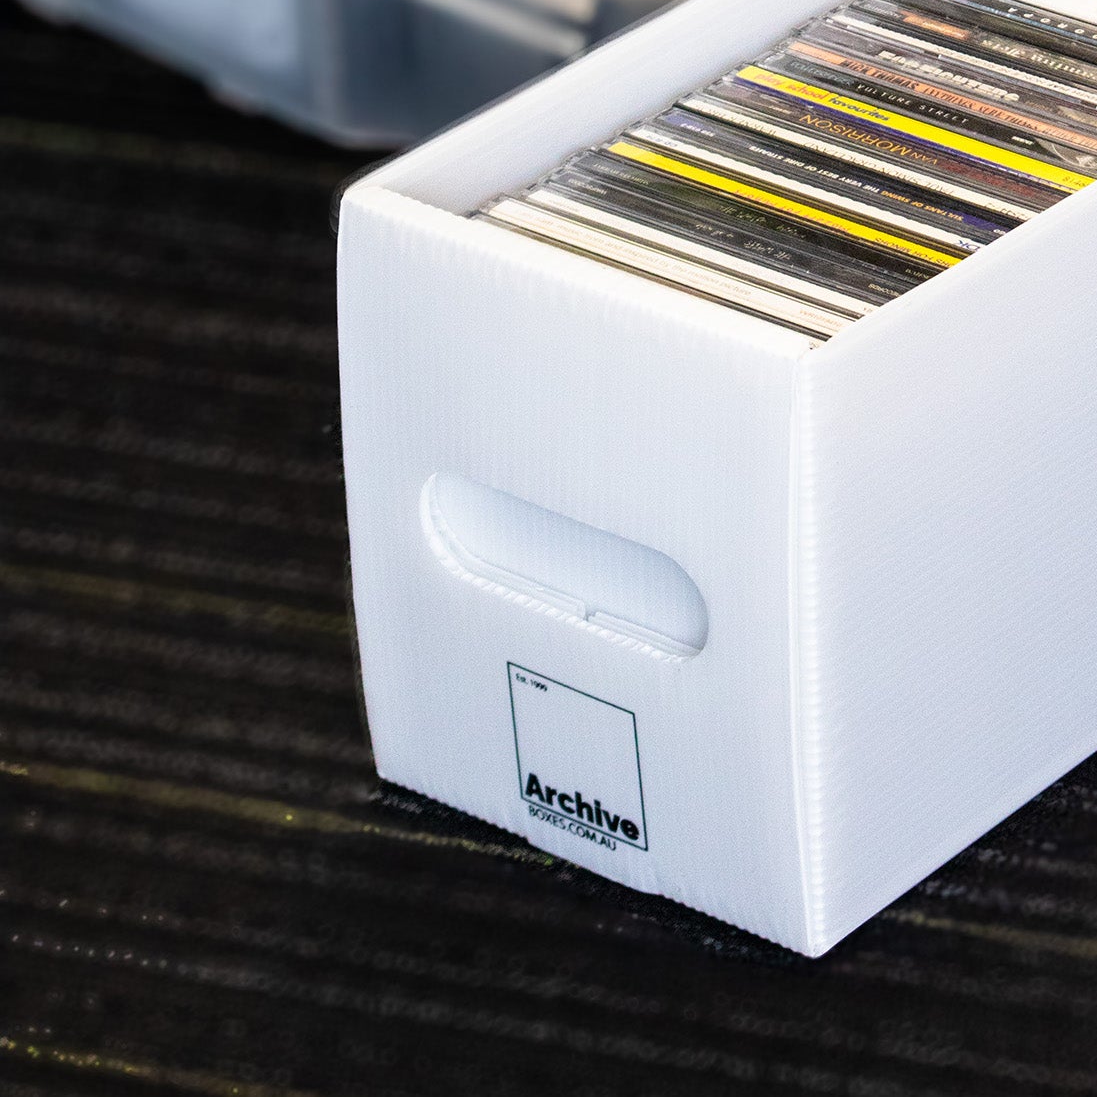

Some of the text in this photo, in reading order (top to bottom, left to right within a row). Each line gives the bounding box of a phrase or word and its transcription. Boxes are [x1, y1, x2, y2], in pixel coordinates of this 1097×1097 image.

[839, 57, 871, 75] MICK
[871, 67, 919, 90] THOMAS
[787, 81, 829, 100] school
[828, 96, 890, 122] favourites
[856, 84, 911, 106] VULTURE
[918, 103, 970, 124] STREET
[799, 114, 938, 166] VAN MORRISON
[750, 145, 784, 161] STRAITS
[785, 156, 804, 168] DIRE
[804, 164, 817, 172] OF
[818, 168, 840, 180] BEST
[839, 176, 862, 188] VERY
[863, 184, 880, 194] THE
[881, 190, 911, 203] SWING
[911, 199, 925, 207] OF
[874, 236, 911, 255] MINORS
[525, 772, 640, 841] Archive
[528, 804, 617, 852] BOXES.COM.AU
